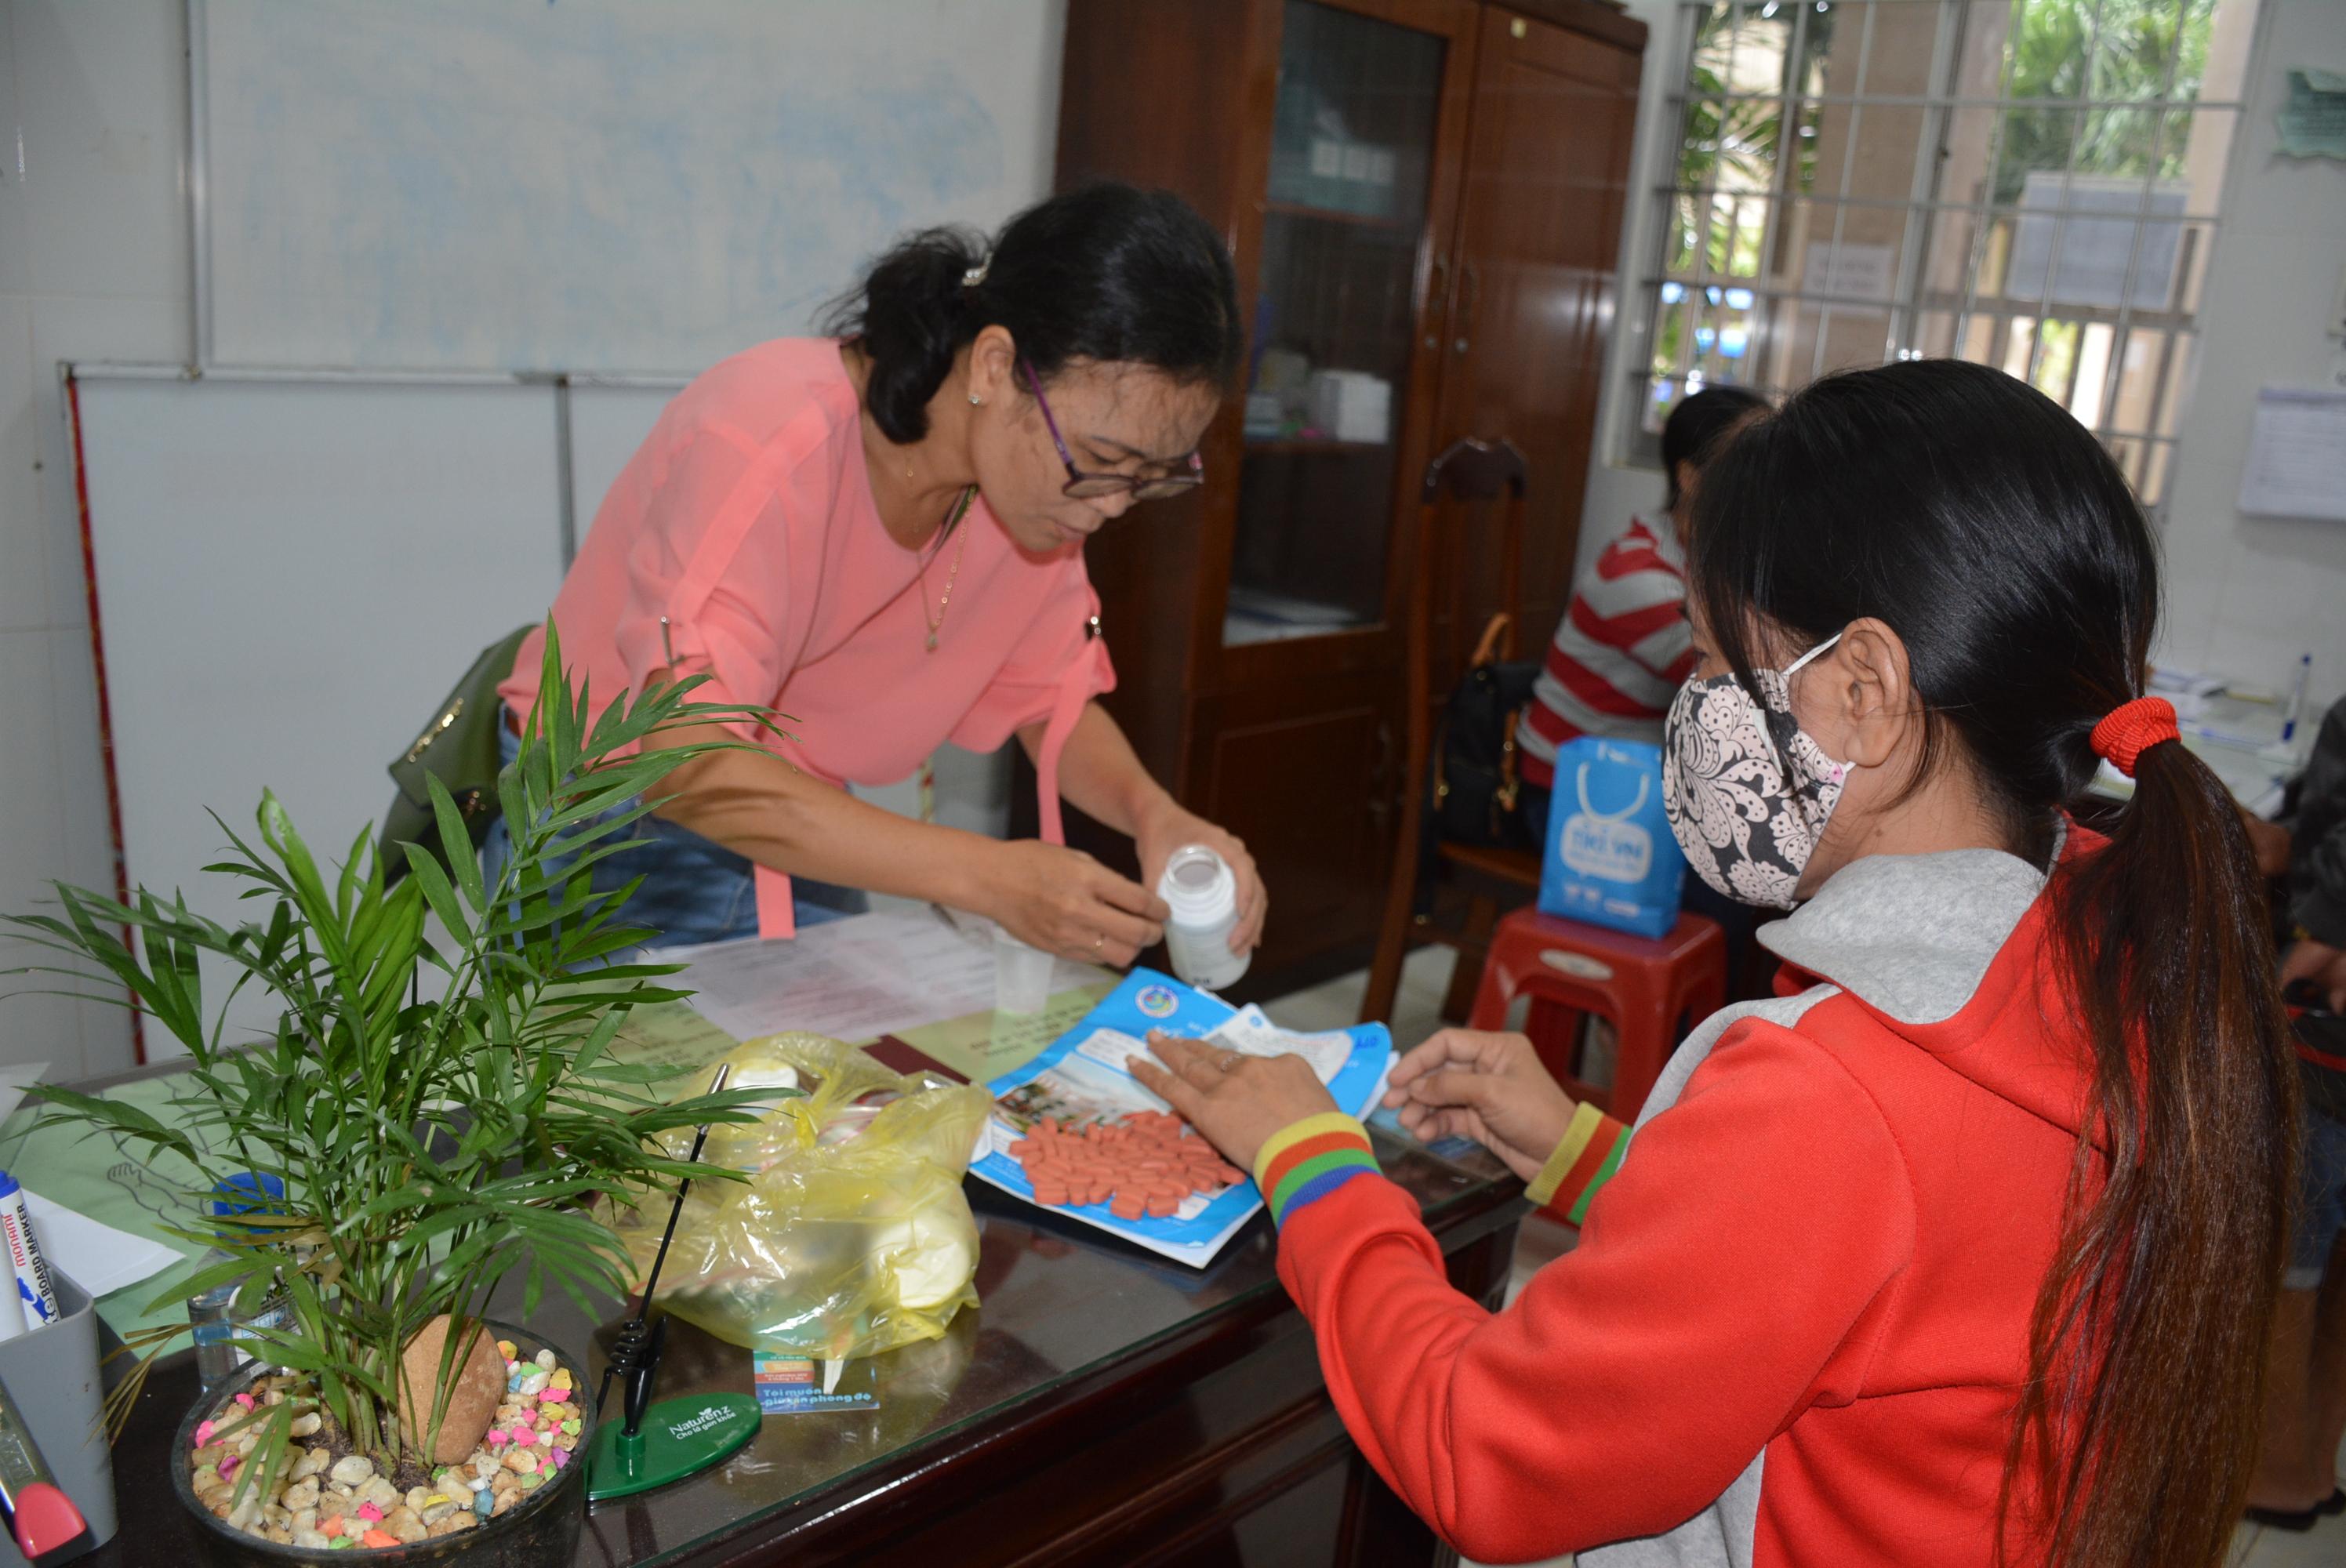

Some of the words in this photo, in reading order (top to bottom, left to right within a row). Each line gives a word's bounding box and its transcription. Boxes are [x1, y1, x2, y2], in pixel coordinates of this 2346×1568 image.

[17, 1203, 38, 1255] MARKER
[32, 1256, 50, 1298] BOARD
[669, 1406, 731, 1435] Naturenz
[677, 1430, 692, 1439] Cho
